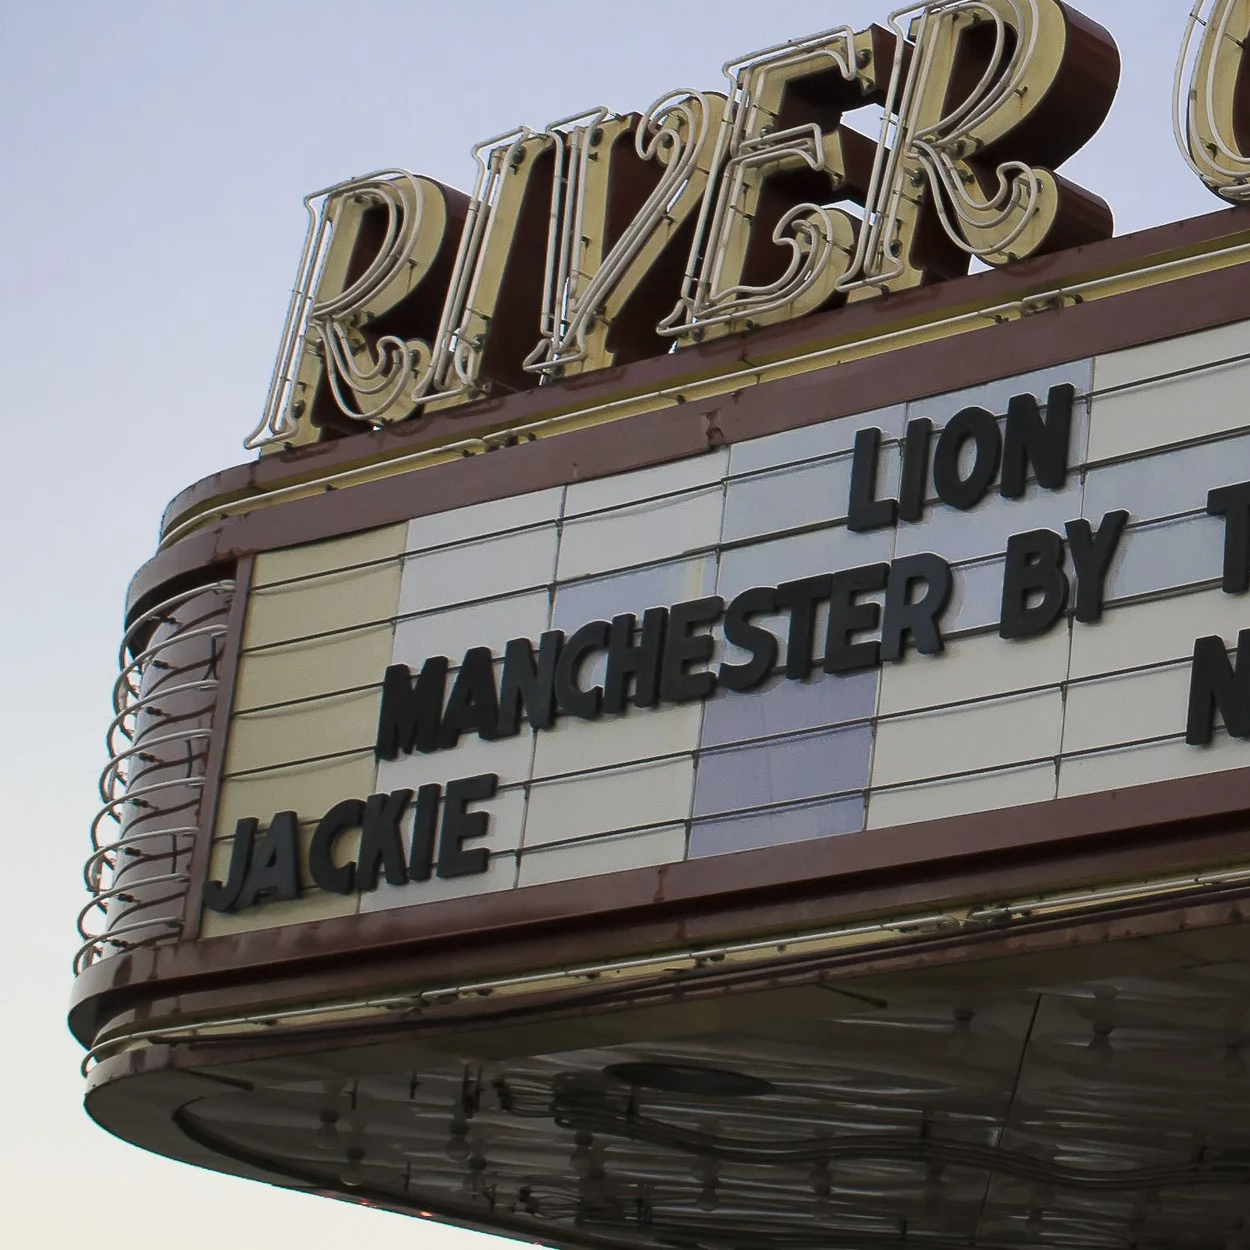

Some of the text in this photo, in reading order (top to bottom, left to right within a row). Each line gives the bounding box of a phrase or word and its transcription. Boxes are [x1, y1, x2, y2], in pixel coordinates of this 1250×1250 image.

[846, 382, 1076, 532] LION
[374, 551, 953, 762] MANCHESTER
[998, 508, 1130, 640] BY
[203, 772, 500, 915] JACKIE
